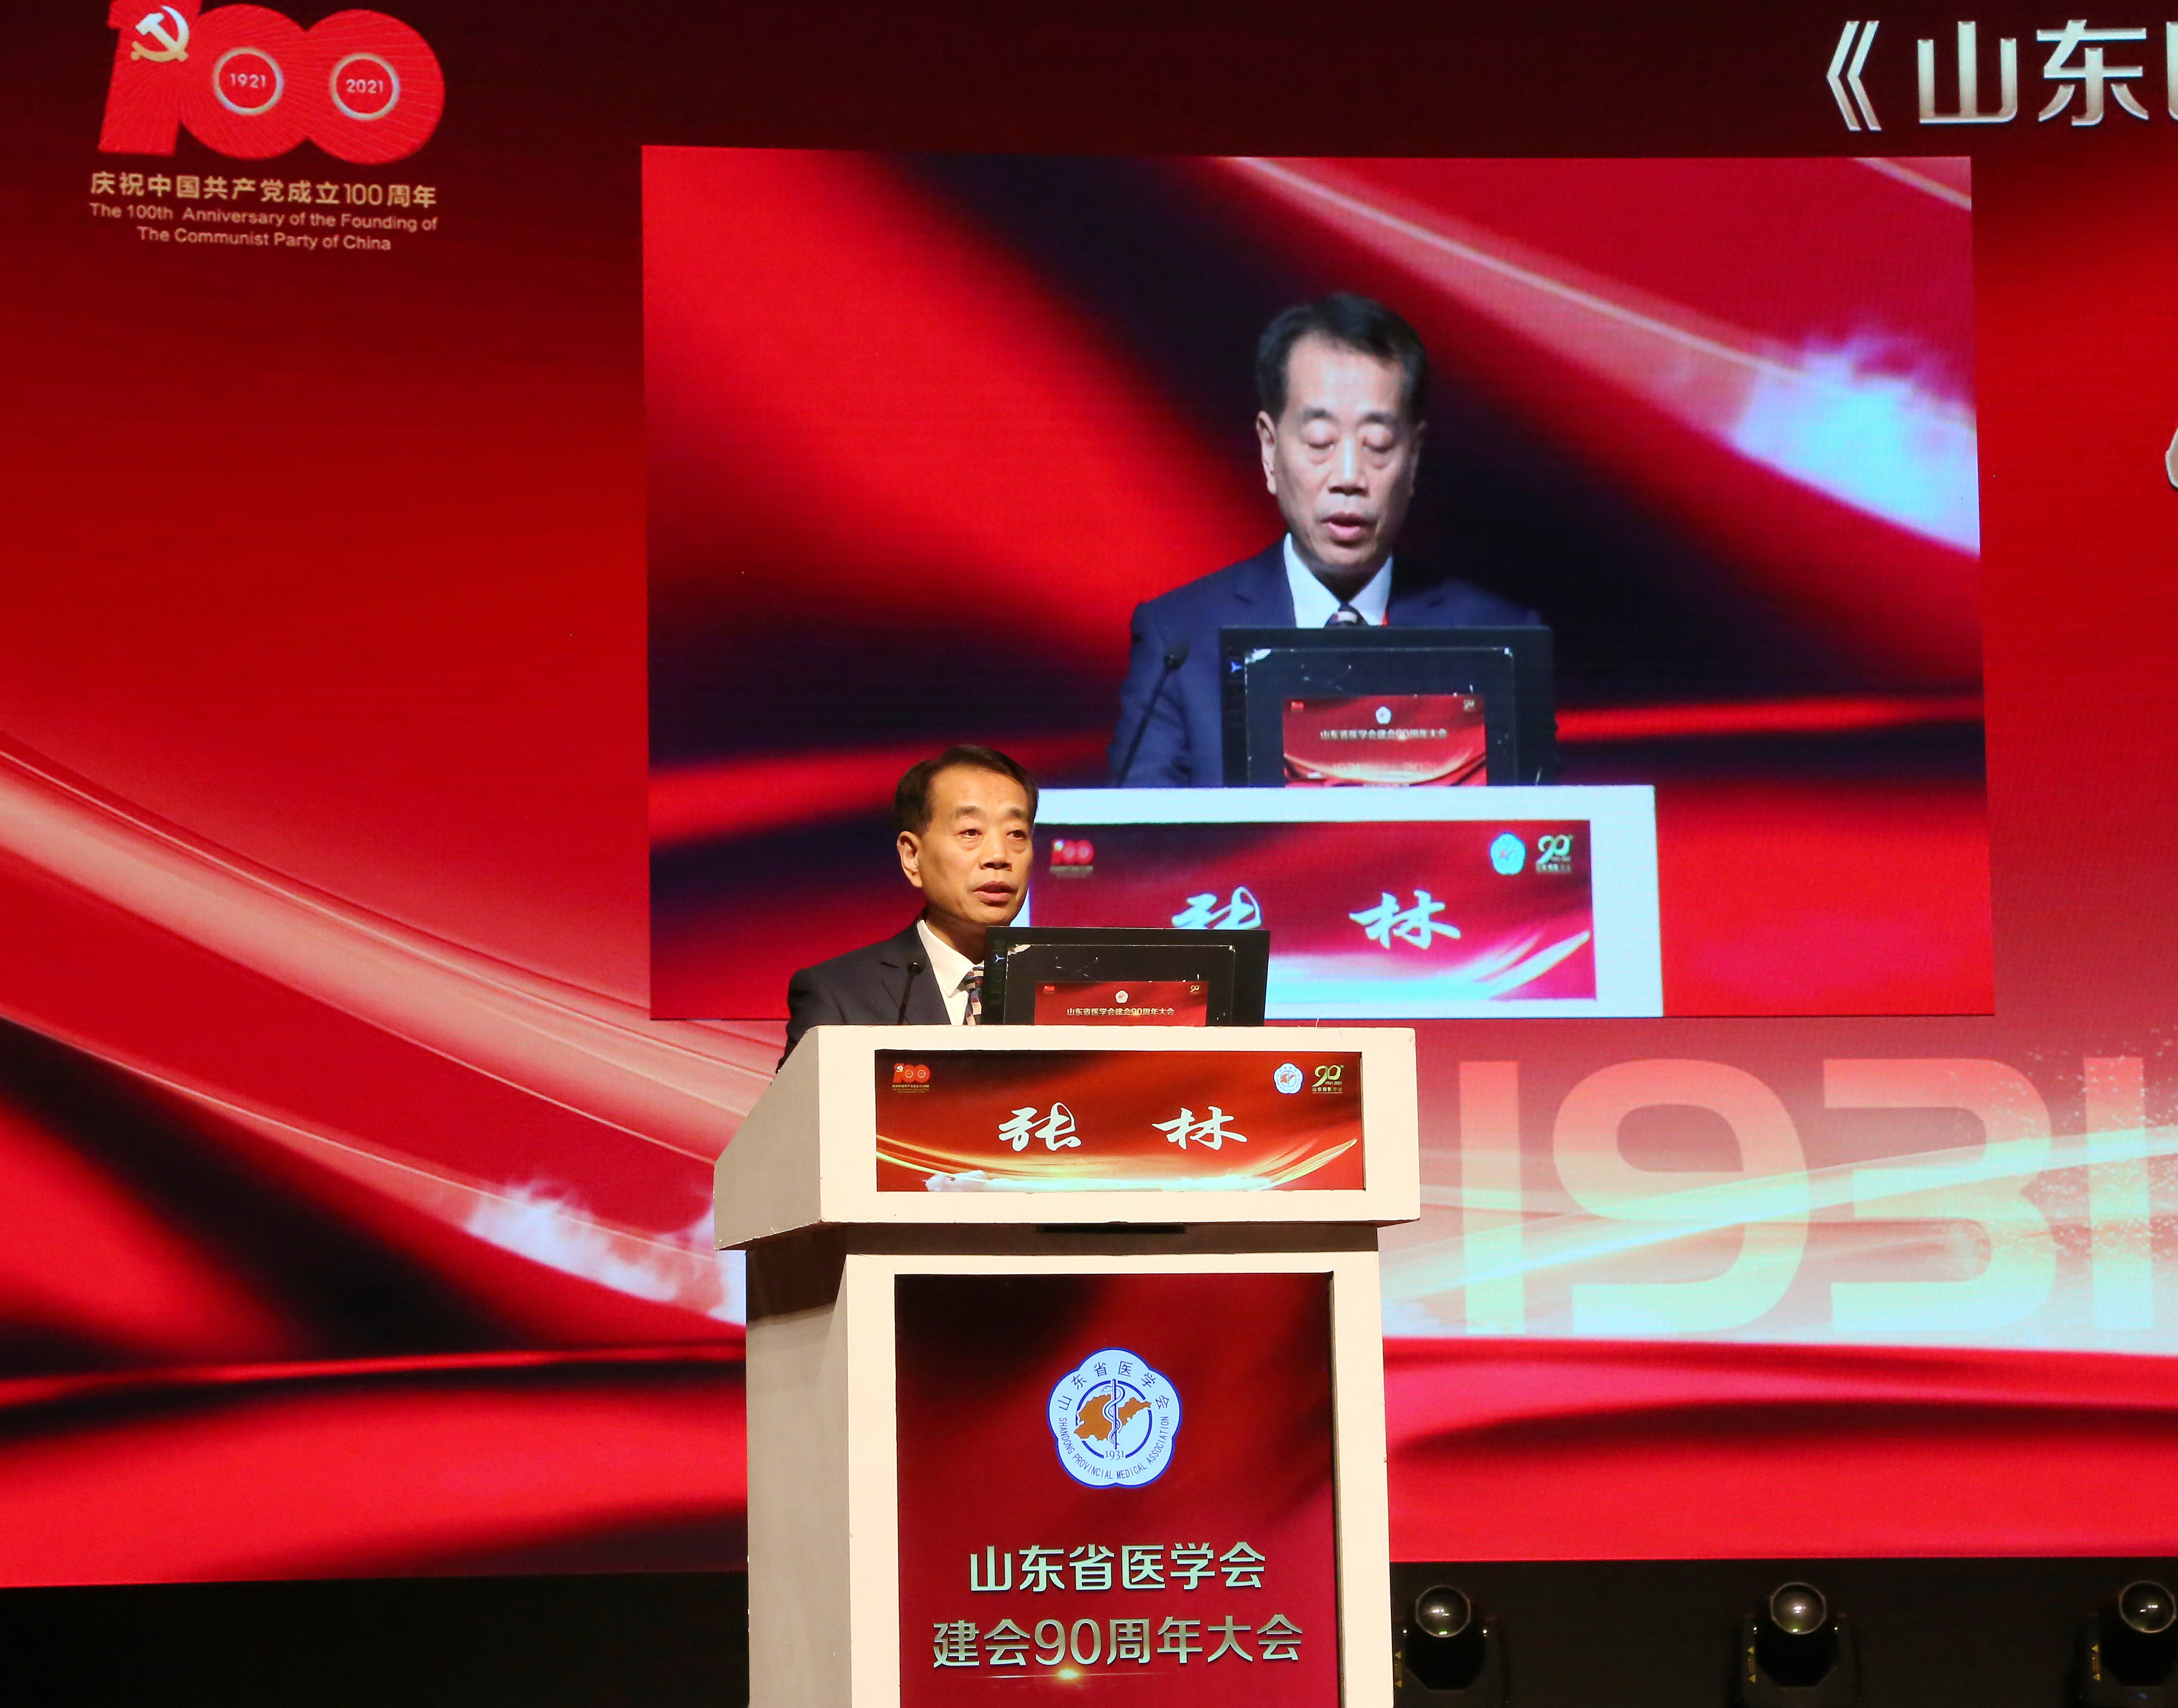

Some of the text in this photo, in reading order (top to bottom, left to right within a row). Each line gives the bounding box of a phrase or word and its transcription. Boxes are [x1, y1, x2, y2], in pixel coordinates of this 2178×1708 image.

[229, 73, 267, 88] 1921
[346, 79, 384, 94] 2021
[1827, 19, 2178, 132] 《山东
[91, 171, 437, 208] 庆祝中国共产党成立100周年
[89, 202, 438, 233] The 100th Anniversary of the Founding of
[136, 225, 391, 250] The Communist Party of China
[1349, 890, 1462, 950] 林
[1067, 1007, 1175, 1016] 山东省医学会建会90周年大会
[1152, 1106, 1248, 1150] 林
[1459, 1058, 2154, 1334] 1931
[1058, 1361, 1169, 1411] 山东省医学会
[1058, 1416, 1169, 1479] SHANDONG PROVINCIAL MEDICAL ASSOCIATION
[1105, 1450, 1125, 1460] 1931
[969, 1541, 1266, 1592] 山东省医学会
[932, 1613, 1303, 1668] 建会90周年大会
